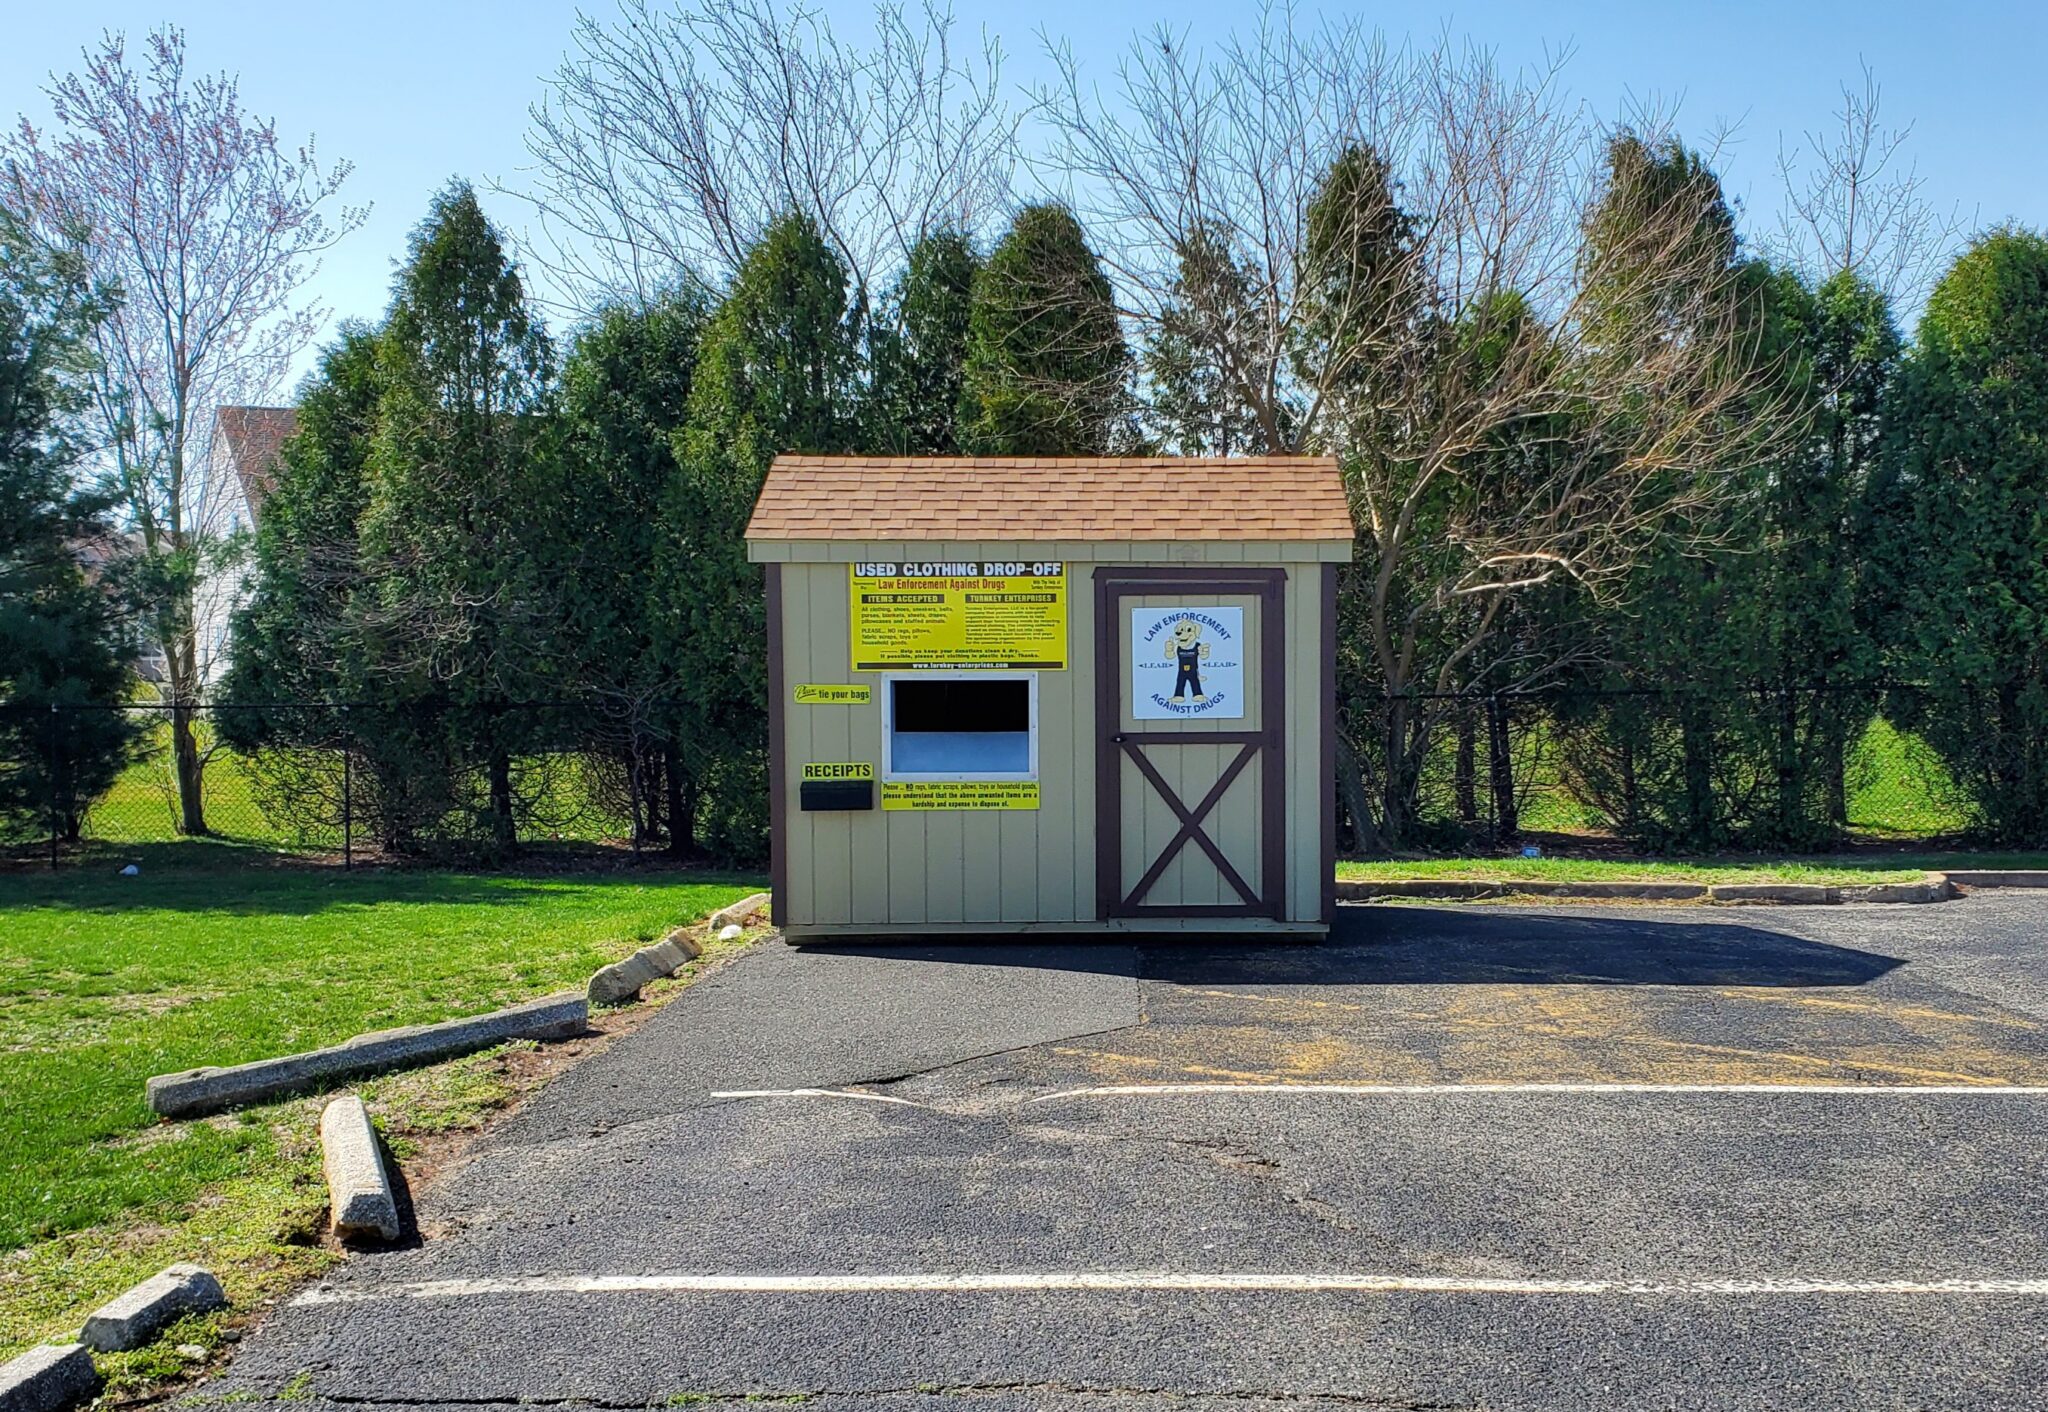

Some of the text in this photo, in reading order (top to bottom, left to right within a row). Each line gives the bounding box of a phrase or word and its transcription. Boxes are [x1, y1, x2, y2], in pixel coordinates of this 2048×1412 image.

[855, 563, 1062, 576] USED CLOTHING DROP-OFF
[878, 579, 894, 590] Law
[896, 579, 947, 590] Enforcement
[950, 579, 980, 591] Against
[982, 579, 1006, 591] Drugs
[1144, 612, 1231, 642] LAW ENFORCEMENT
[819, 690, 829, 698] tie
[832, 691, 848, 700] your
[850, 690, 869, 700] bags
[1151, 692, 1225, 714] AGAINST DRUGS
[805, 765, 870, 777] RECEIPTS
